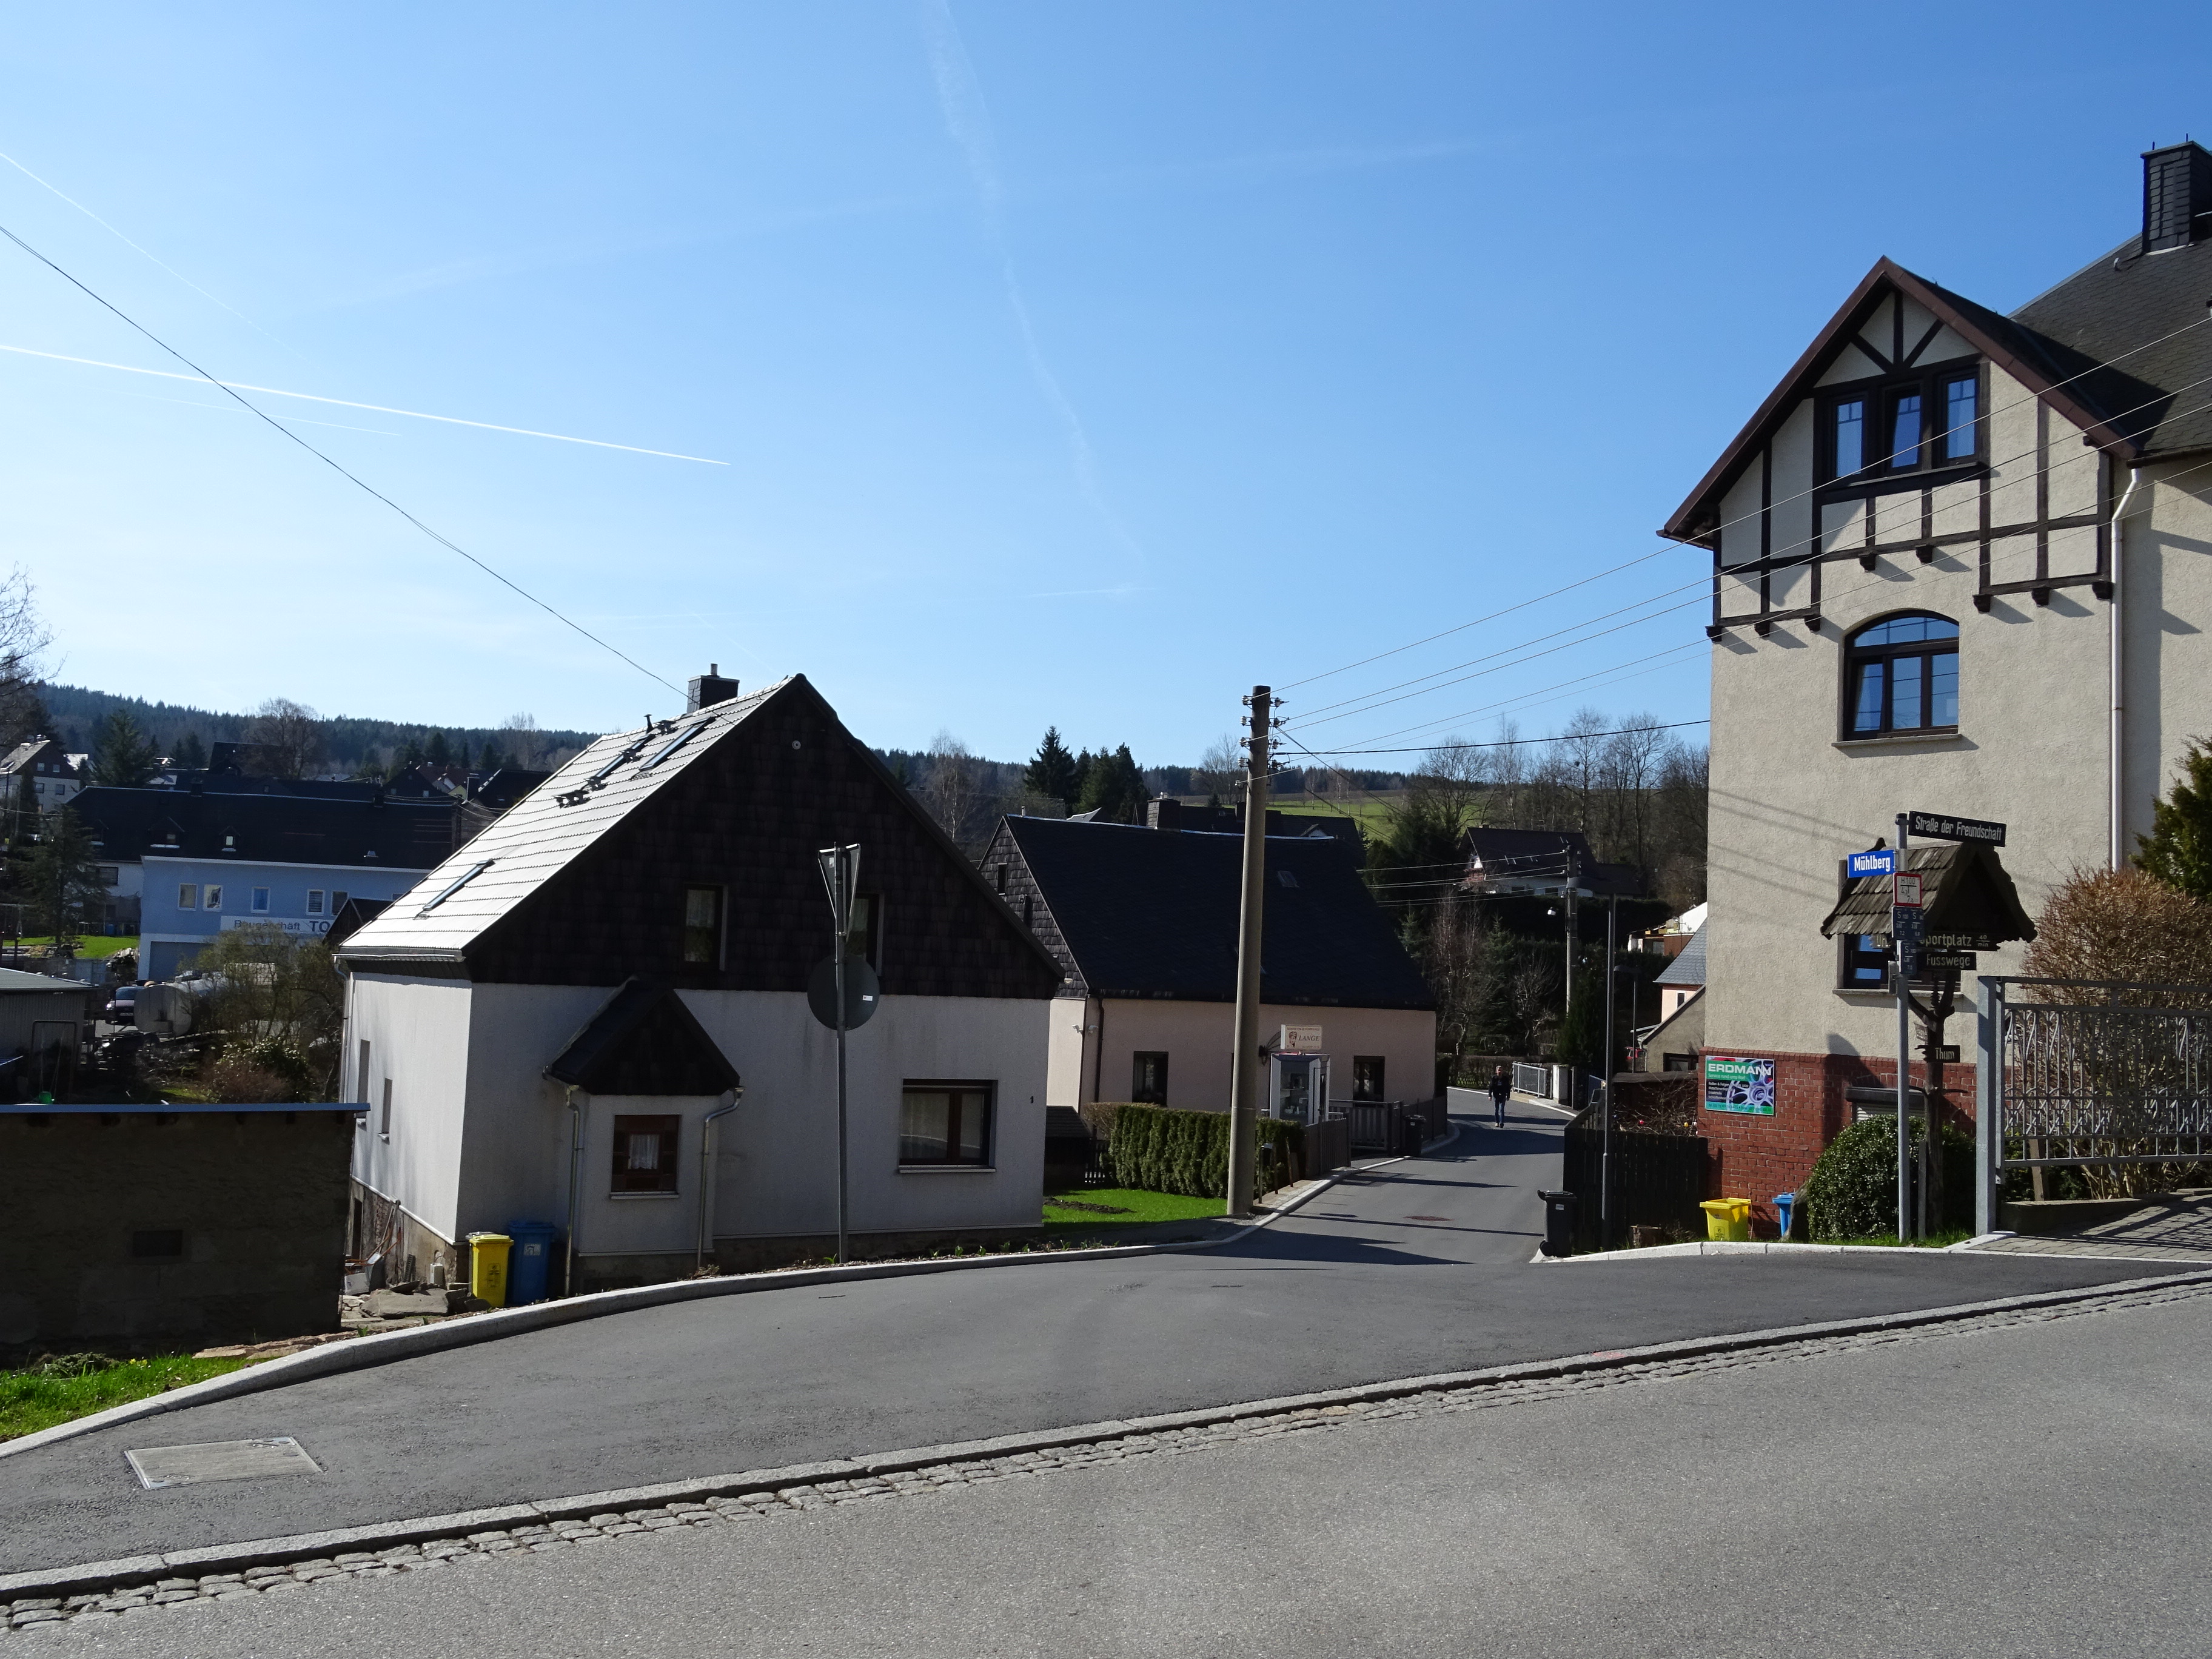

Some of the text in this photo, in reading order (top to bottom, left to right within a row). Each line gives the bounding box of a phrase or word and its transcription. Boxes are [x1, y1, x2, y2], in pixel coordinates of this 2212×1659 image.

[1915, 816, 2002, 841] Straße der Freundschaft
[1854, 854, 1891, 872] Mühlberg
[1926, 953, 1971, 969] Fusswege
[1934, 1047, 1955, 1061] Thum
[1708, 1063, 1771, 1076] ERDMANN
